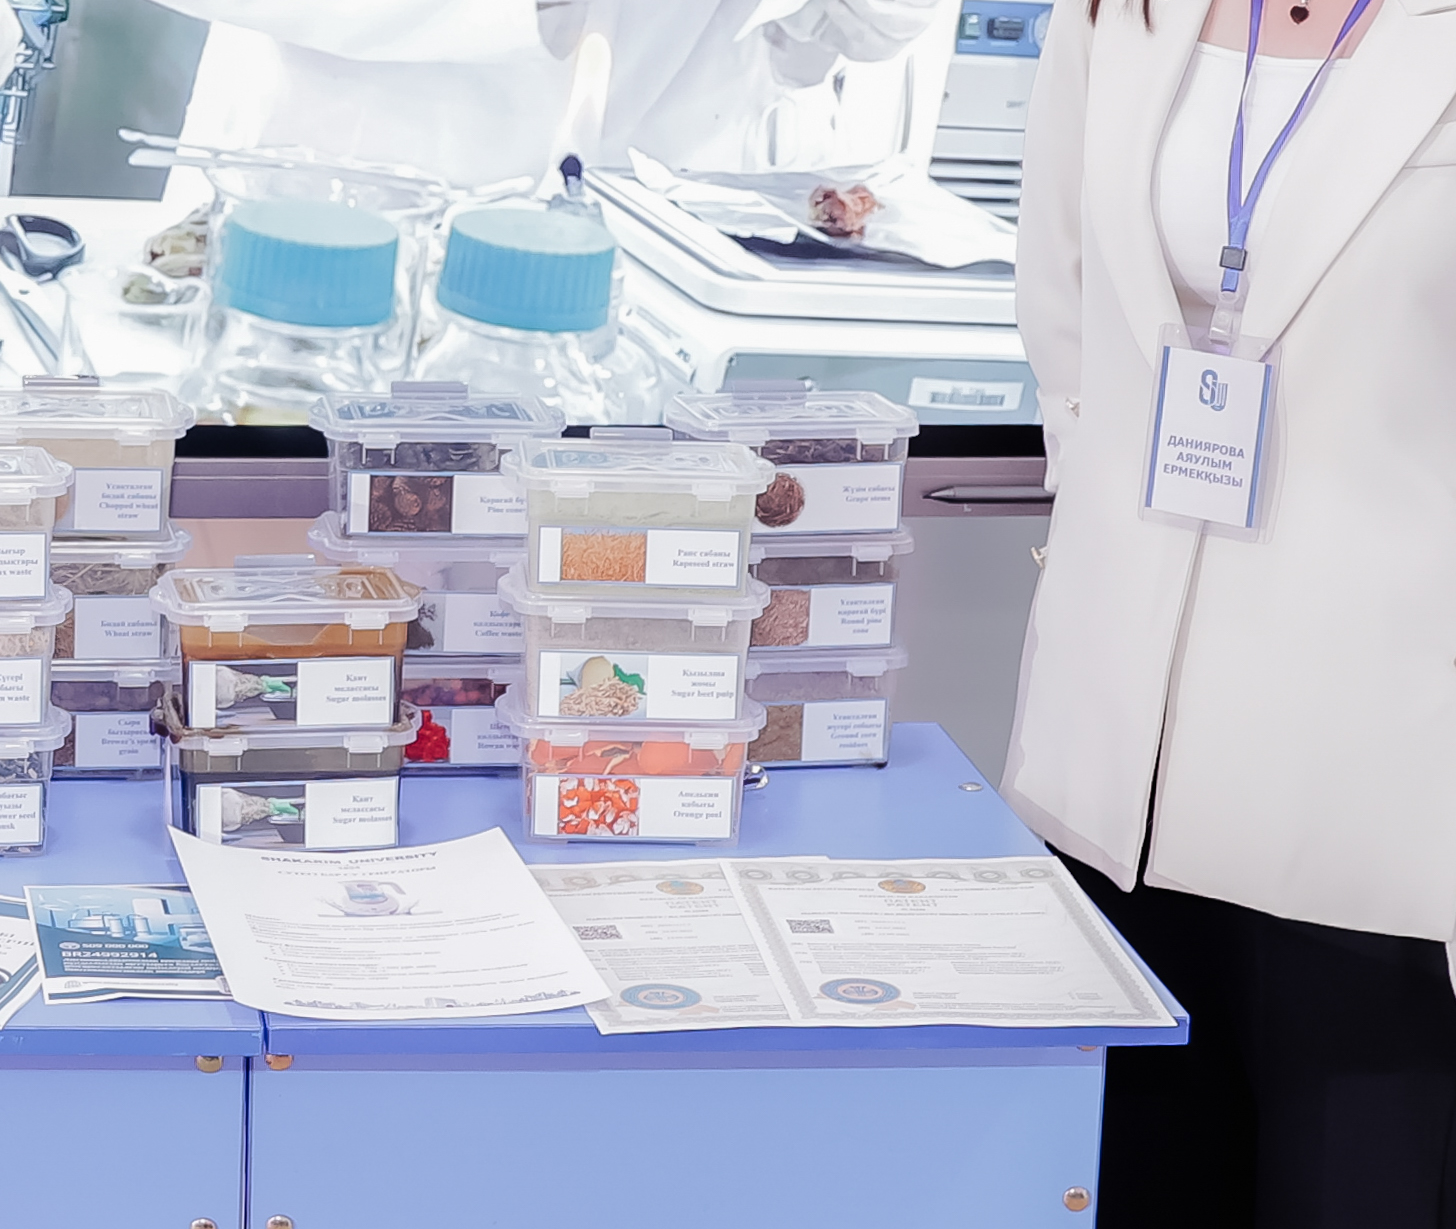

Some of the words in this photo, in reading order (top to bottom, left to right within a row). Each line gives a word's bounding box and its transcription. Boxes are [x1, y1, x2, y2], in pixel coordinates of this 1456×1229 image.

[1166, 435, 1245, 460] ДАНИЯРОВА
[1176, 452, 1233, 471] АЯУЛЫМ
[1162, 463, 1244, 488] ЕРМЕКҚЫЗЫ
[673, 560, 710, 568] Rapeseed
[673, 811, 704, 819] Orange
